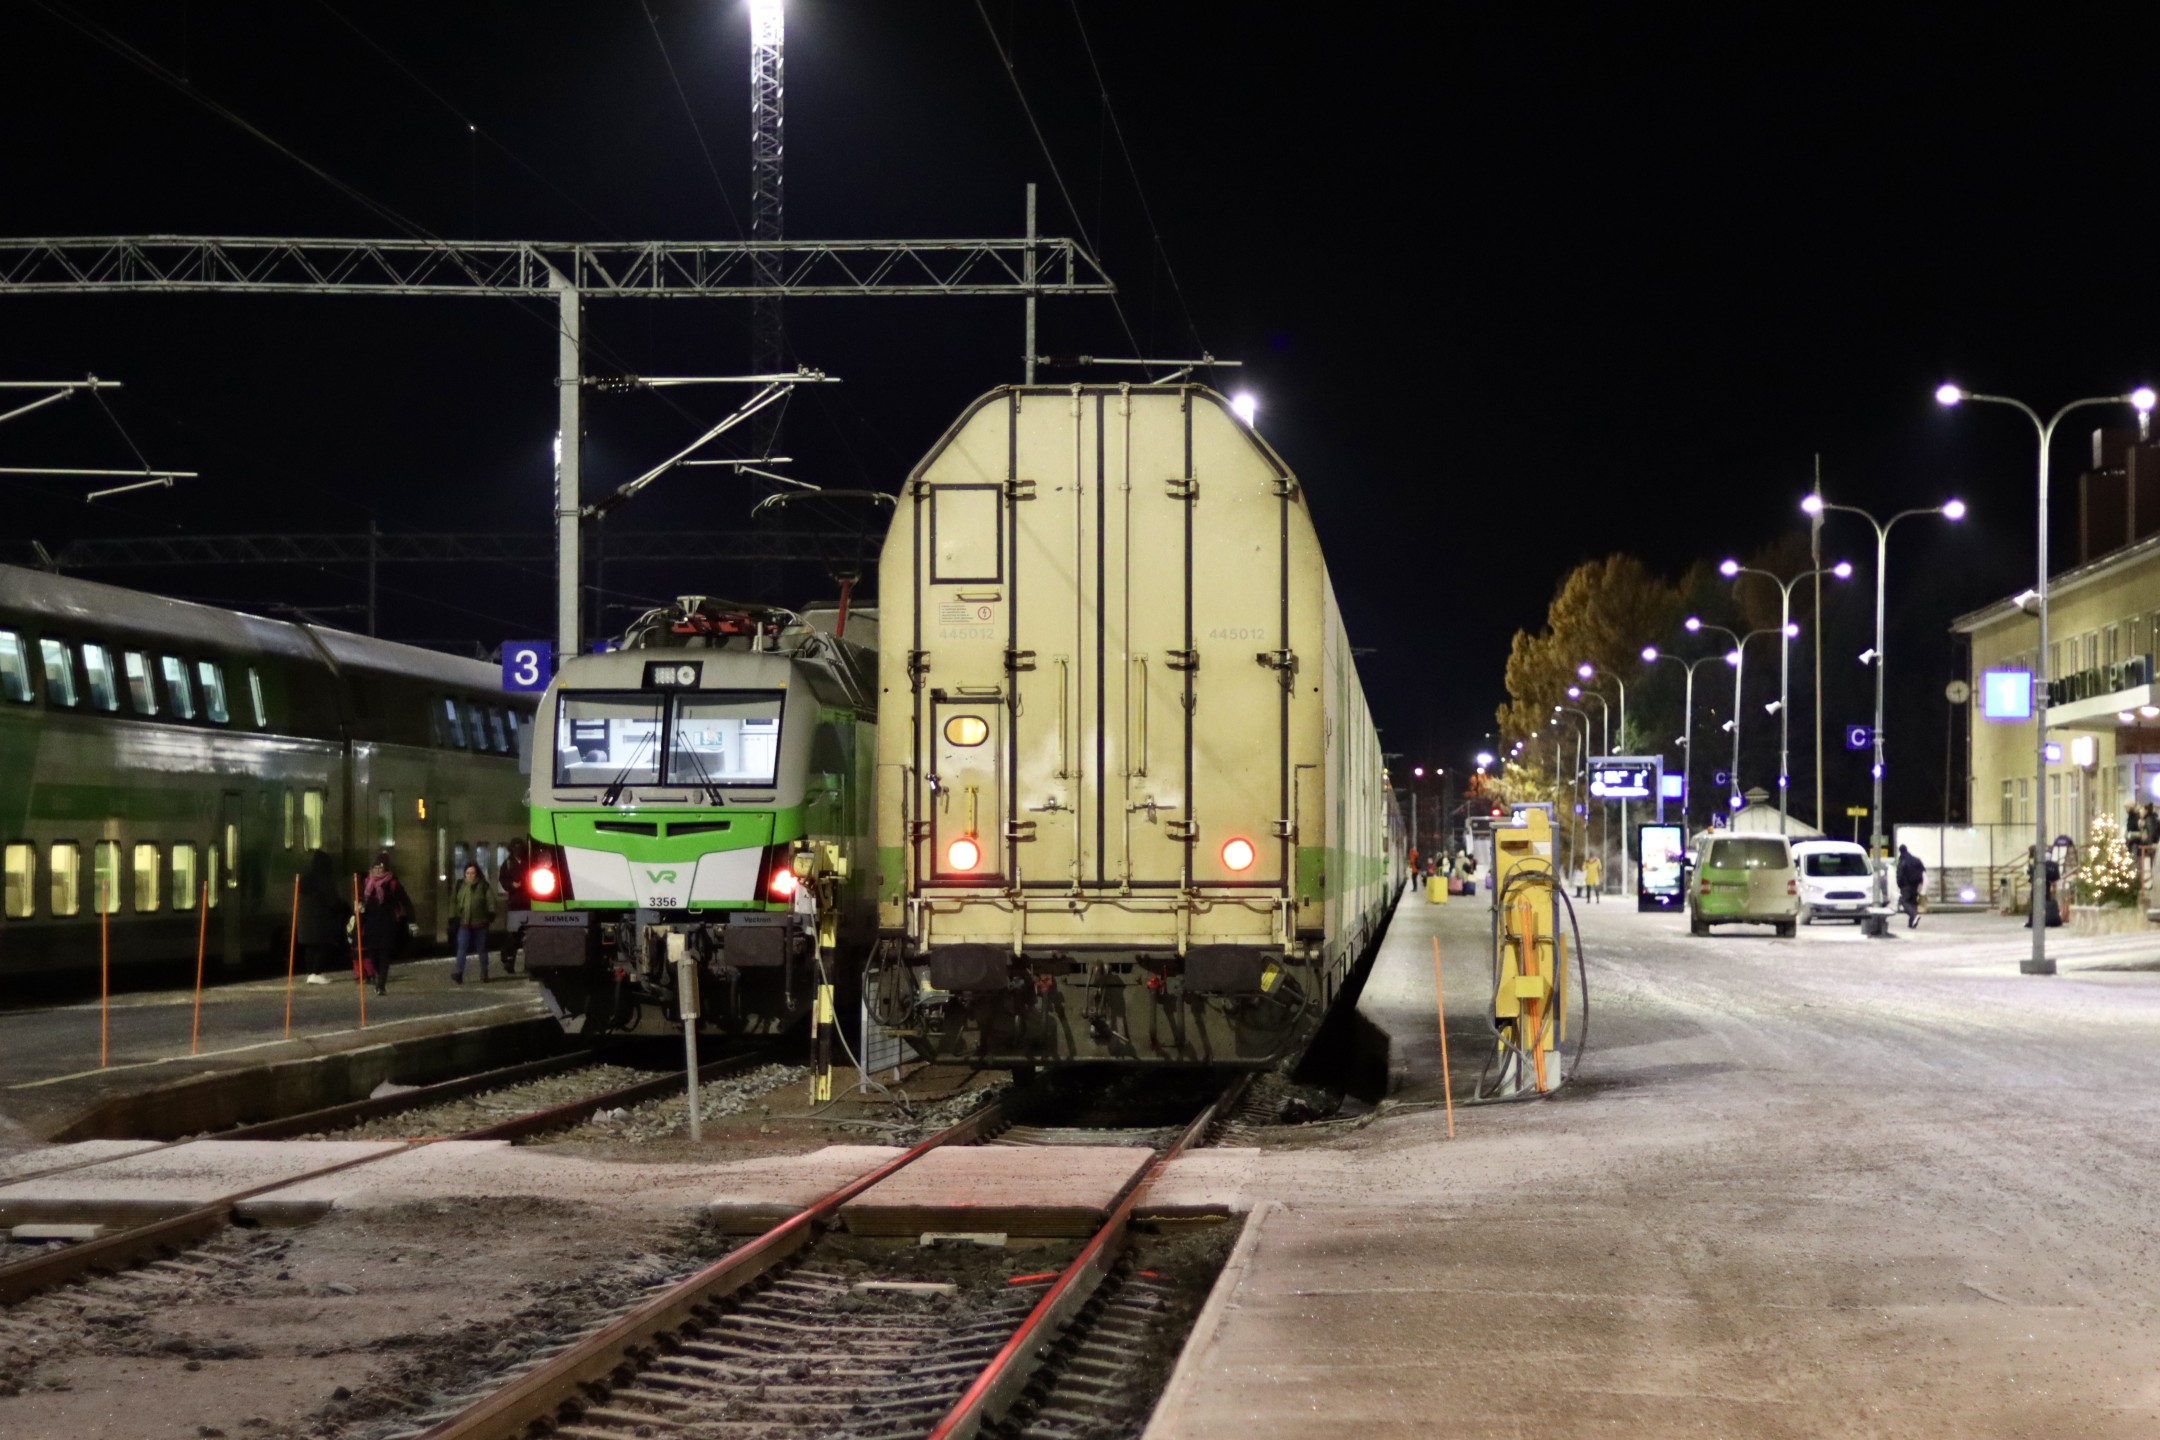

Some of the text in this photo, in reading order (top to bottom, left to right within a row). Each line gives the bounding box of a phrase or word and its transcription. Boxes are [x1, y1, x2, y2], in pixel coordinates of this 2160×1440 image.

[939, 628, 995, 640] 445012
[1209, 628, 1265, 640] 445012
[515, 649, 539, 686] 3
[1998, 678, 2016, 711] 1
[1850, 728, 1867, 747] C
[1715, 771, 1727, 785] C
[646, 869, 677, 884] VR
[649, 897, 677, 907] 3356
[743, 915, 772, 923] Vectron
